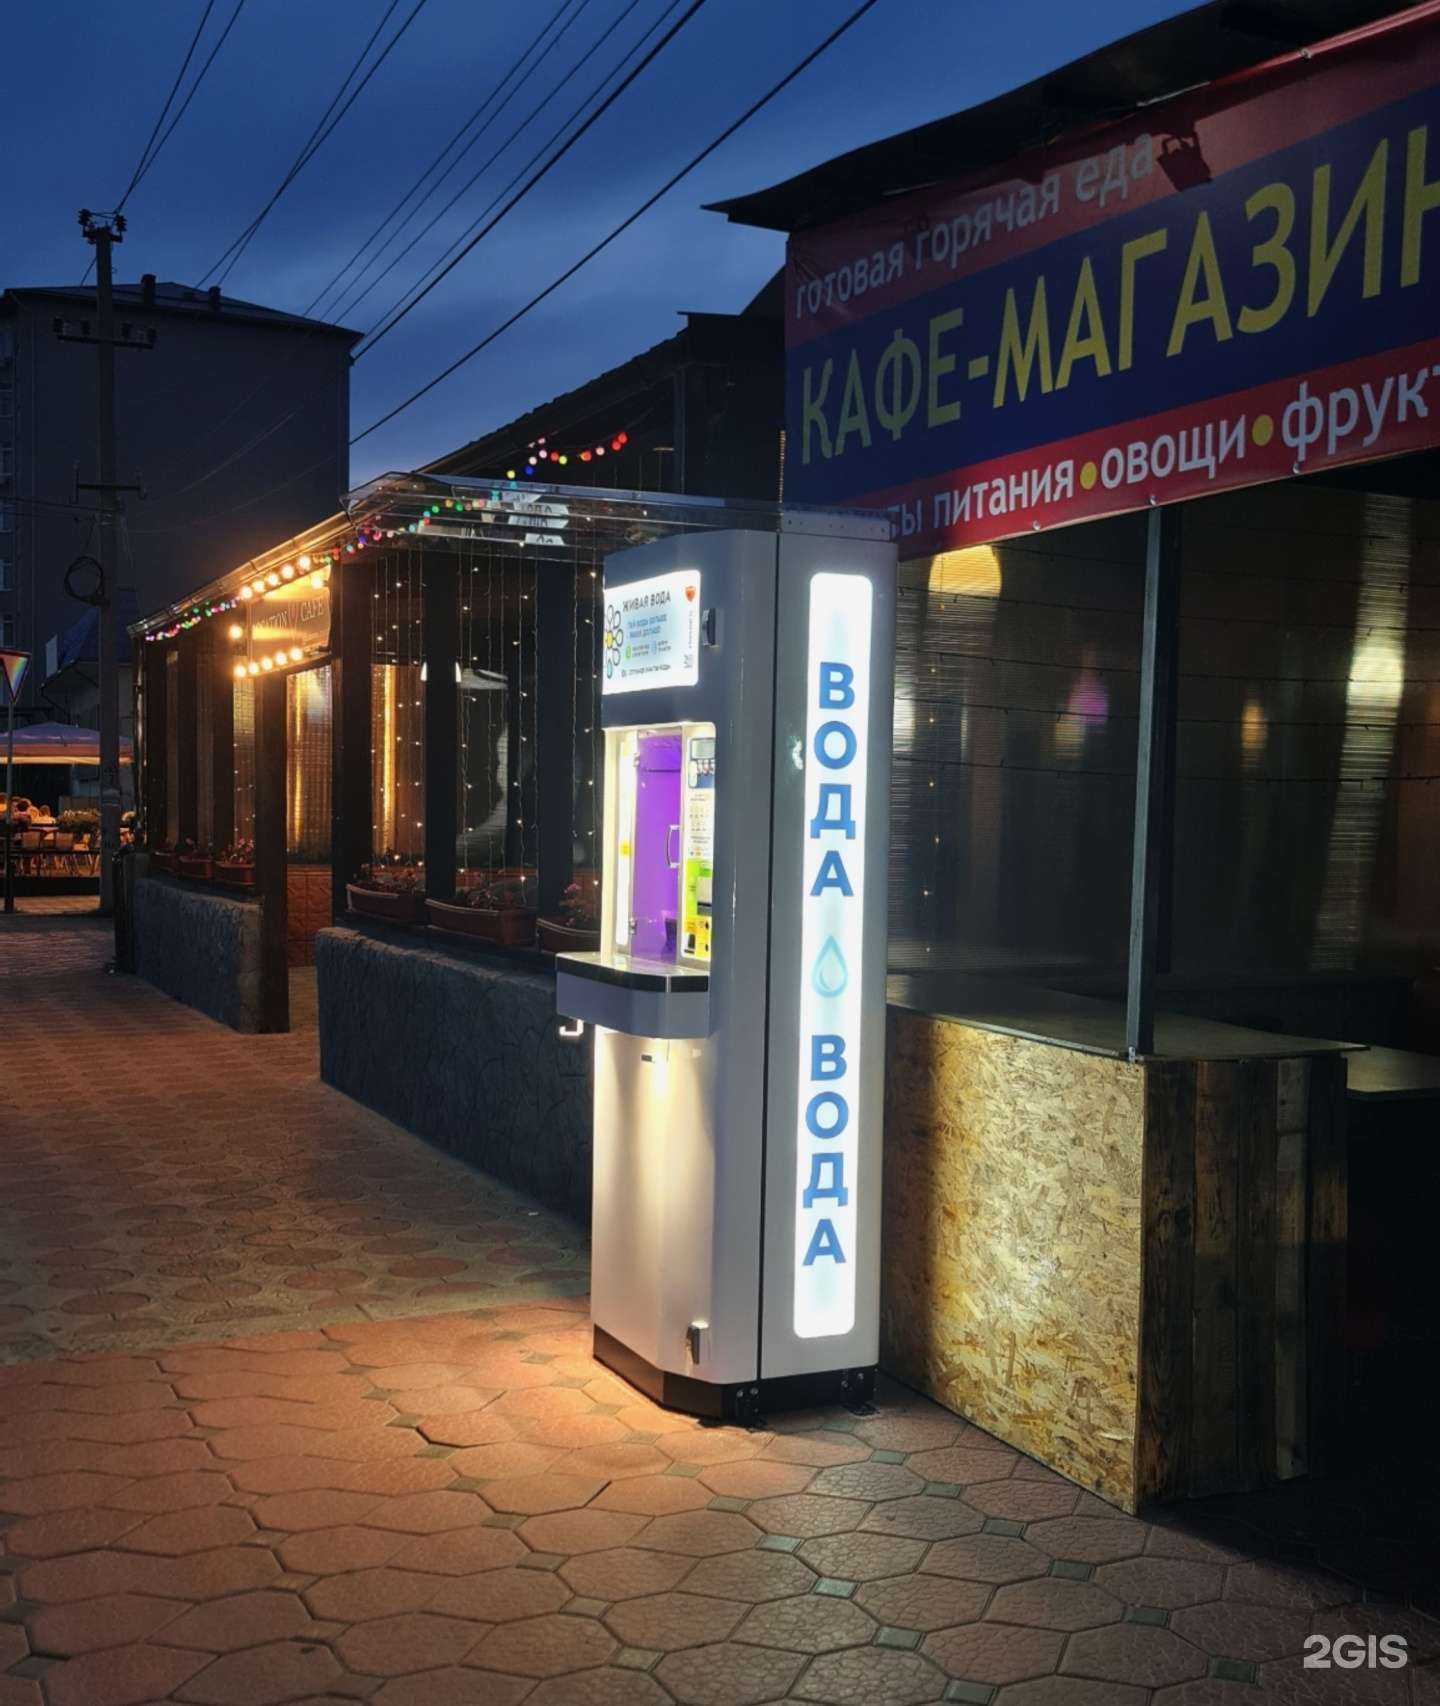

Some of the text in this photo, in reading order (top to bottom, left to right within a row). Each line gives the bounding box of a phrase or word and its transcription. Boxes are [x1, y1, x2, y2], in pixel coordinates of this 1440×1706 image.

[796, 133, 1158, 319] готовая горячая еда
[932, 459, 1075, 528] питания
[1101, 414, 1246, 489] овощи
[810, 661, 857, 897] ВОДА
[802, 1035, 849, 1267] ВОДА
